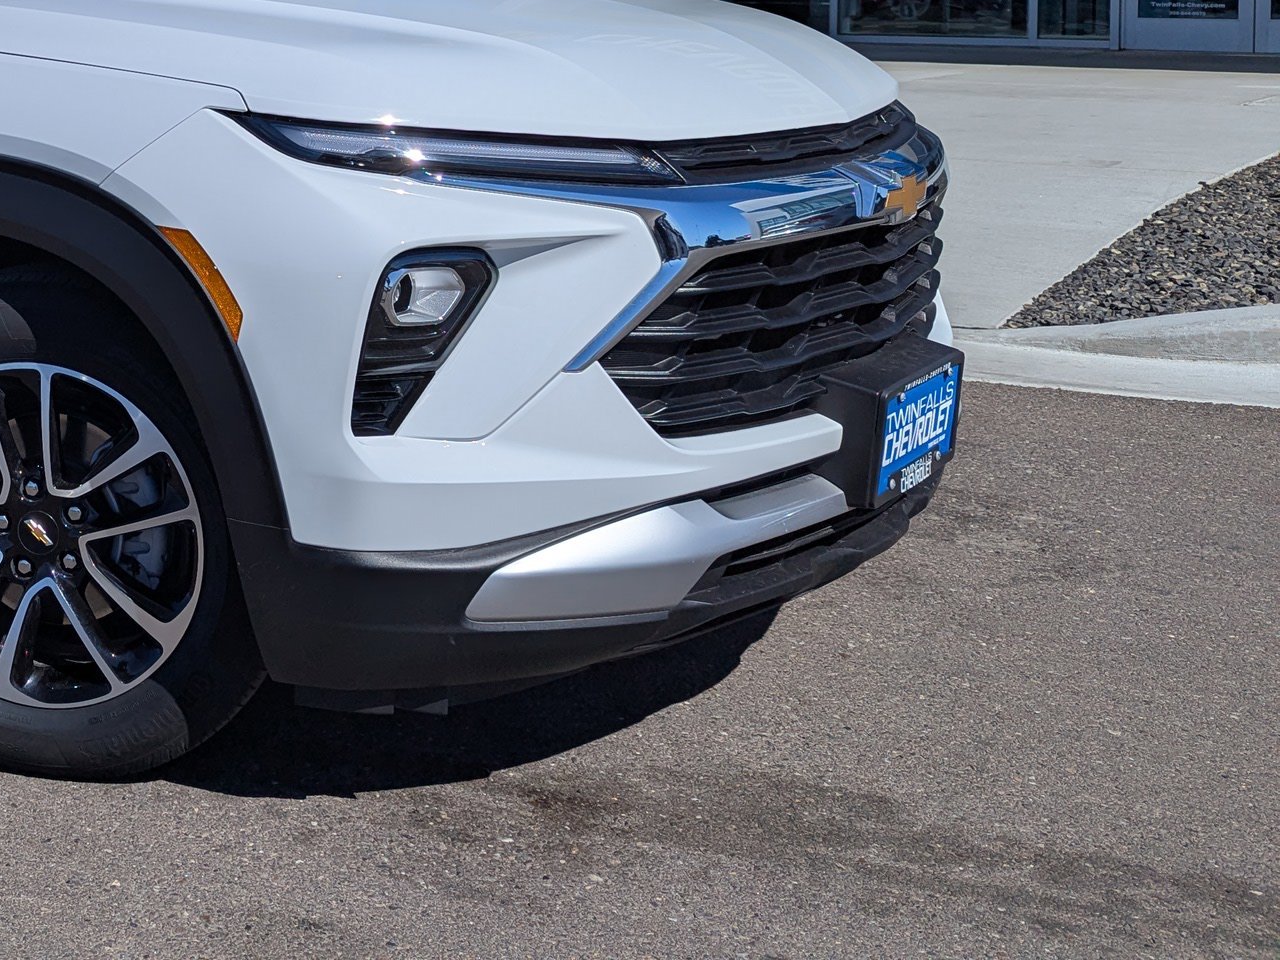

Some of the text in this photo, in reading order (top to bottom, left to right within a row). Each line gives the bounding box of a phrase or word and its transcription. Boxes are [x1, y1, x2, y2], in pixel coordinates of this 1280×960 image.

[886, 380, 954, 433] TWINFALLS
[881, 398, 953, 468] CHEVROLET
[900, 461, 933, 493] CHEVROLET
[901, 451, 933, 477] TWINFALLS
